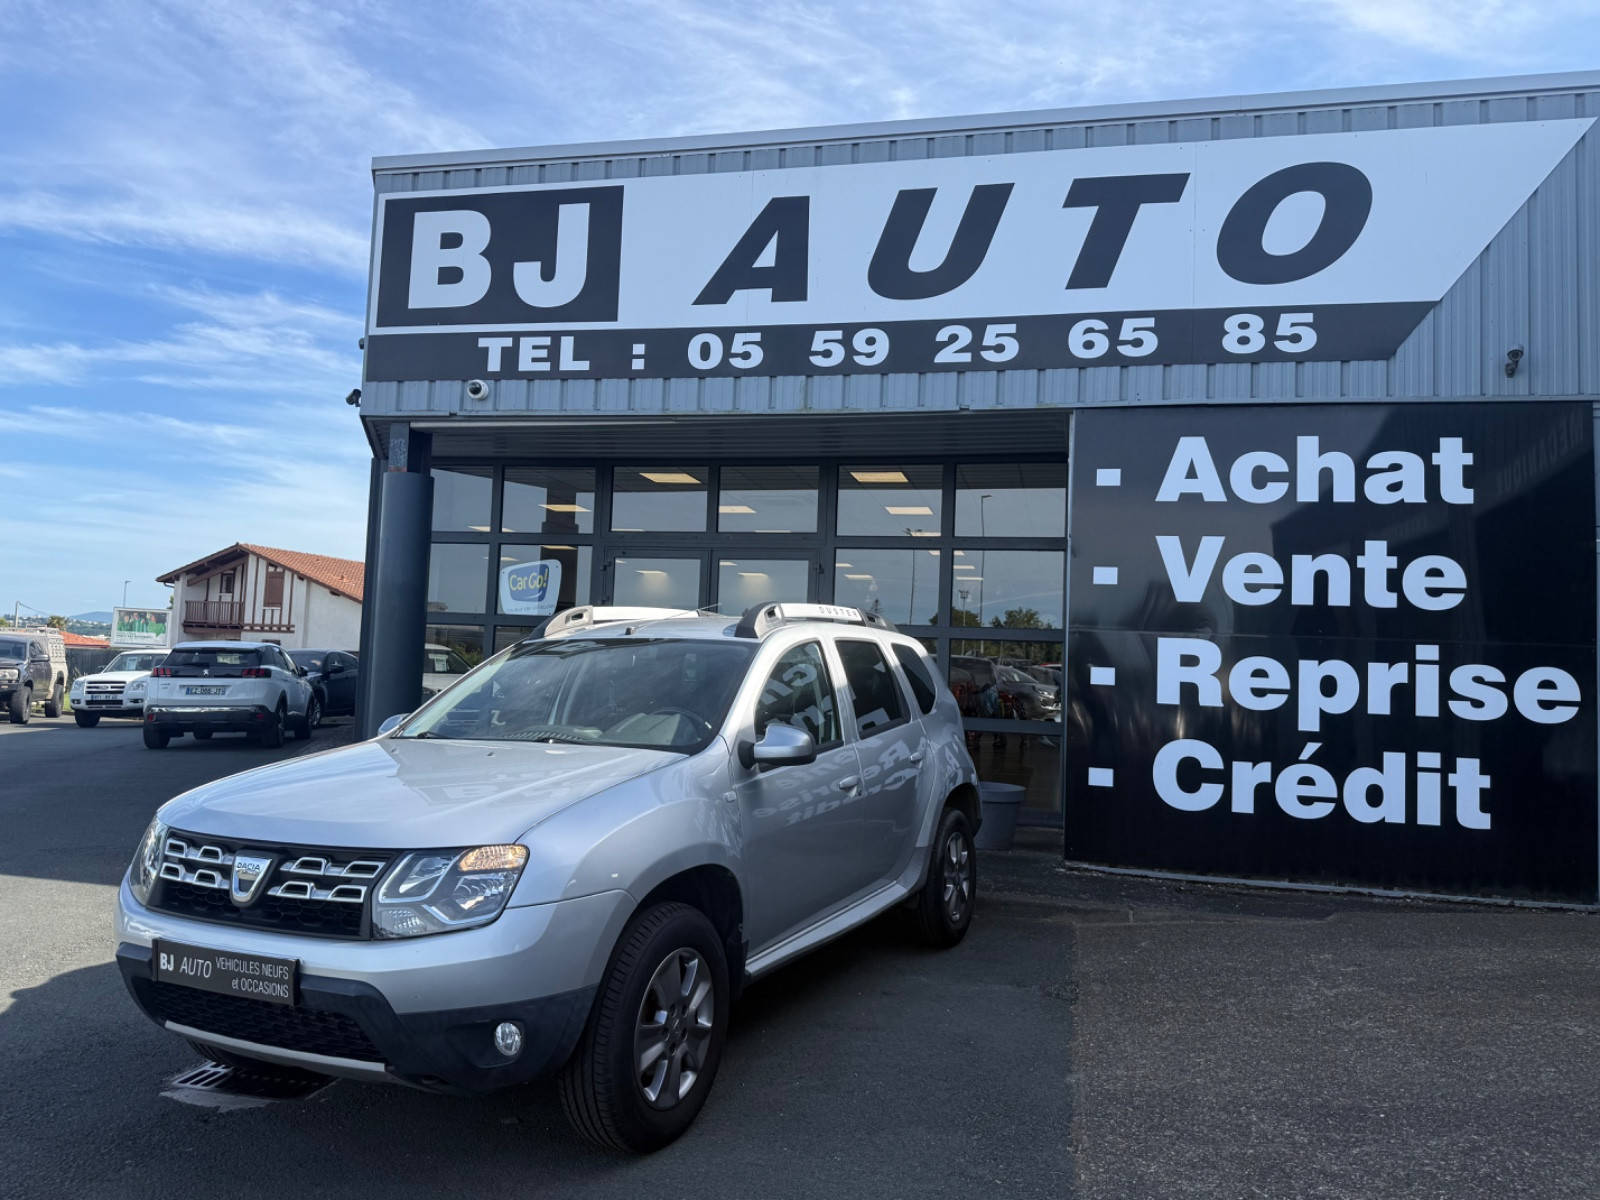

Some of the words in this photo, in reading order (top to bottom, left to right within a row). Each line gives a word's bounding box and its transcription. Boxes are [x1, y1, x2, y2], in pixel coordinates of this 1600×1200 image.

[408, 203, 590, 309] BJ
[691, 162, 1373, 305] AUTO
[478, 336, 590, 372] TEL
[688, 333, 764, 370] 05
[809, 329, 890, 367] 59
[934, 324, 1020, 363] 25
[1068, 317, 1159, 358] 65
[1222, 312, 1318, 354] 85
[1155, 435, 1474, 504] Achat
[1155, 536, 1468, 611] Vente
[819, 606, 858, 618] DUSTER
[1157, 637, 1582, 732] Reprise
[1152, 738, 1491, 830] Crédit
[236, 861, 261, 871] DACIA
[160, 953, 174, 971] BJ
[180, 956, 212, 978] AUTO
[215, 957, 260, 975] VEHICULES
[262, 964, 289, 980] NEUFS
[232, 978, 239, 990] et
[240, 978, 289, 998] OCCASIONS
